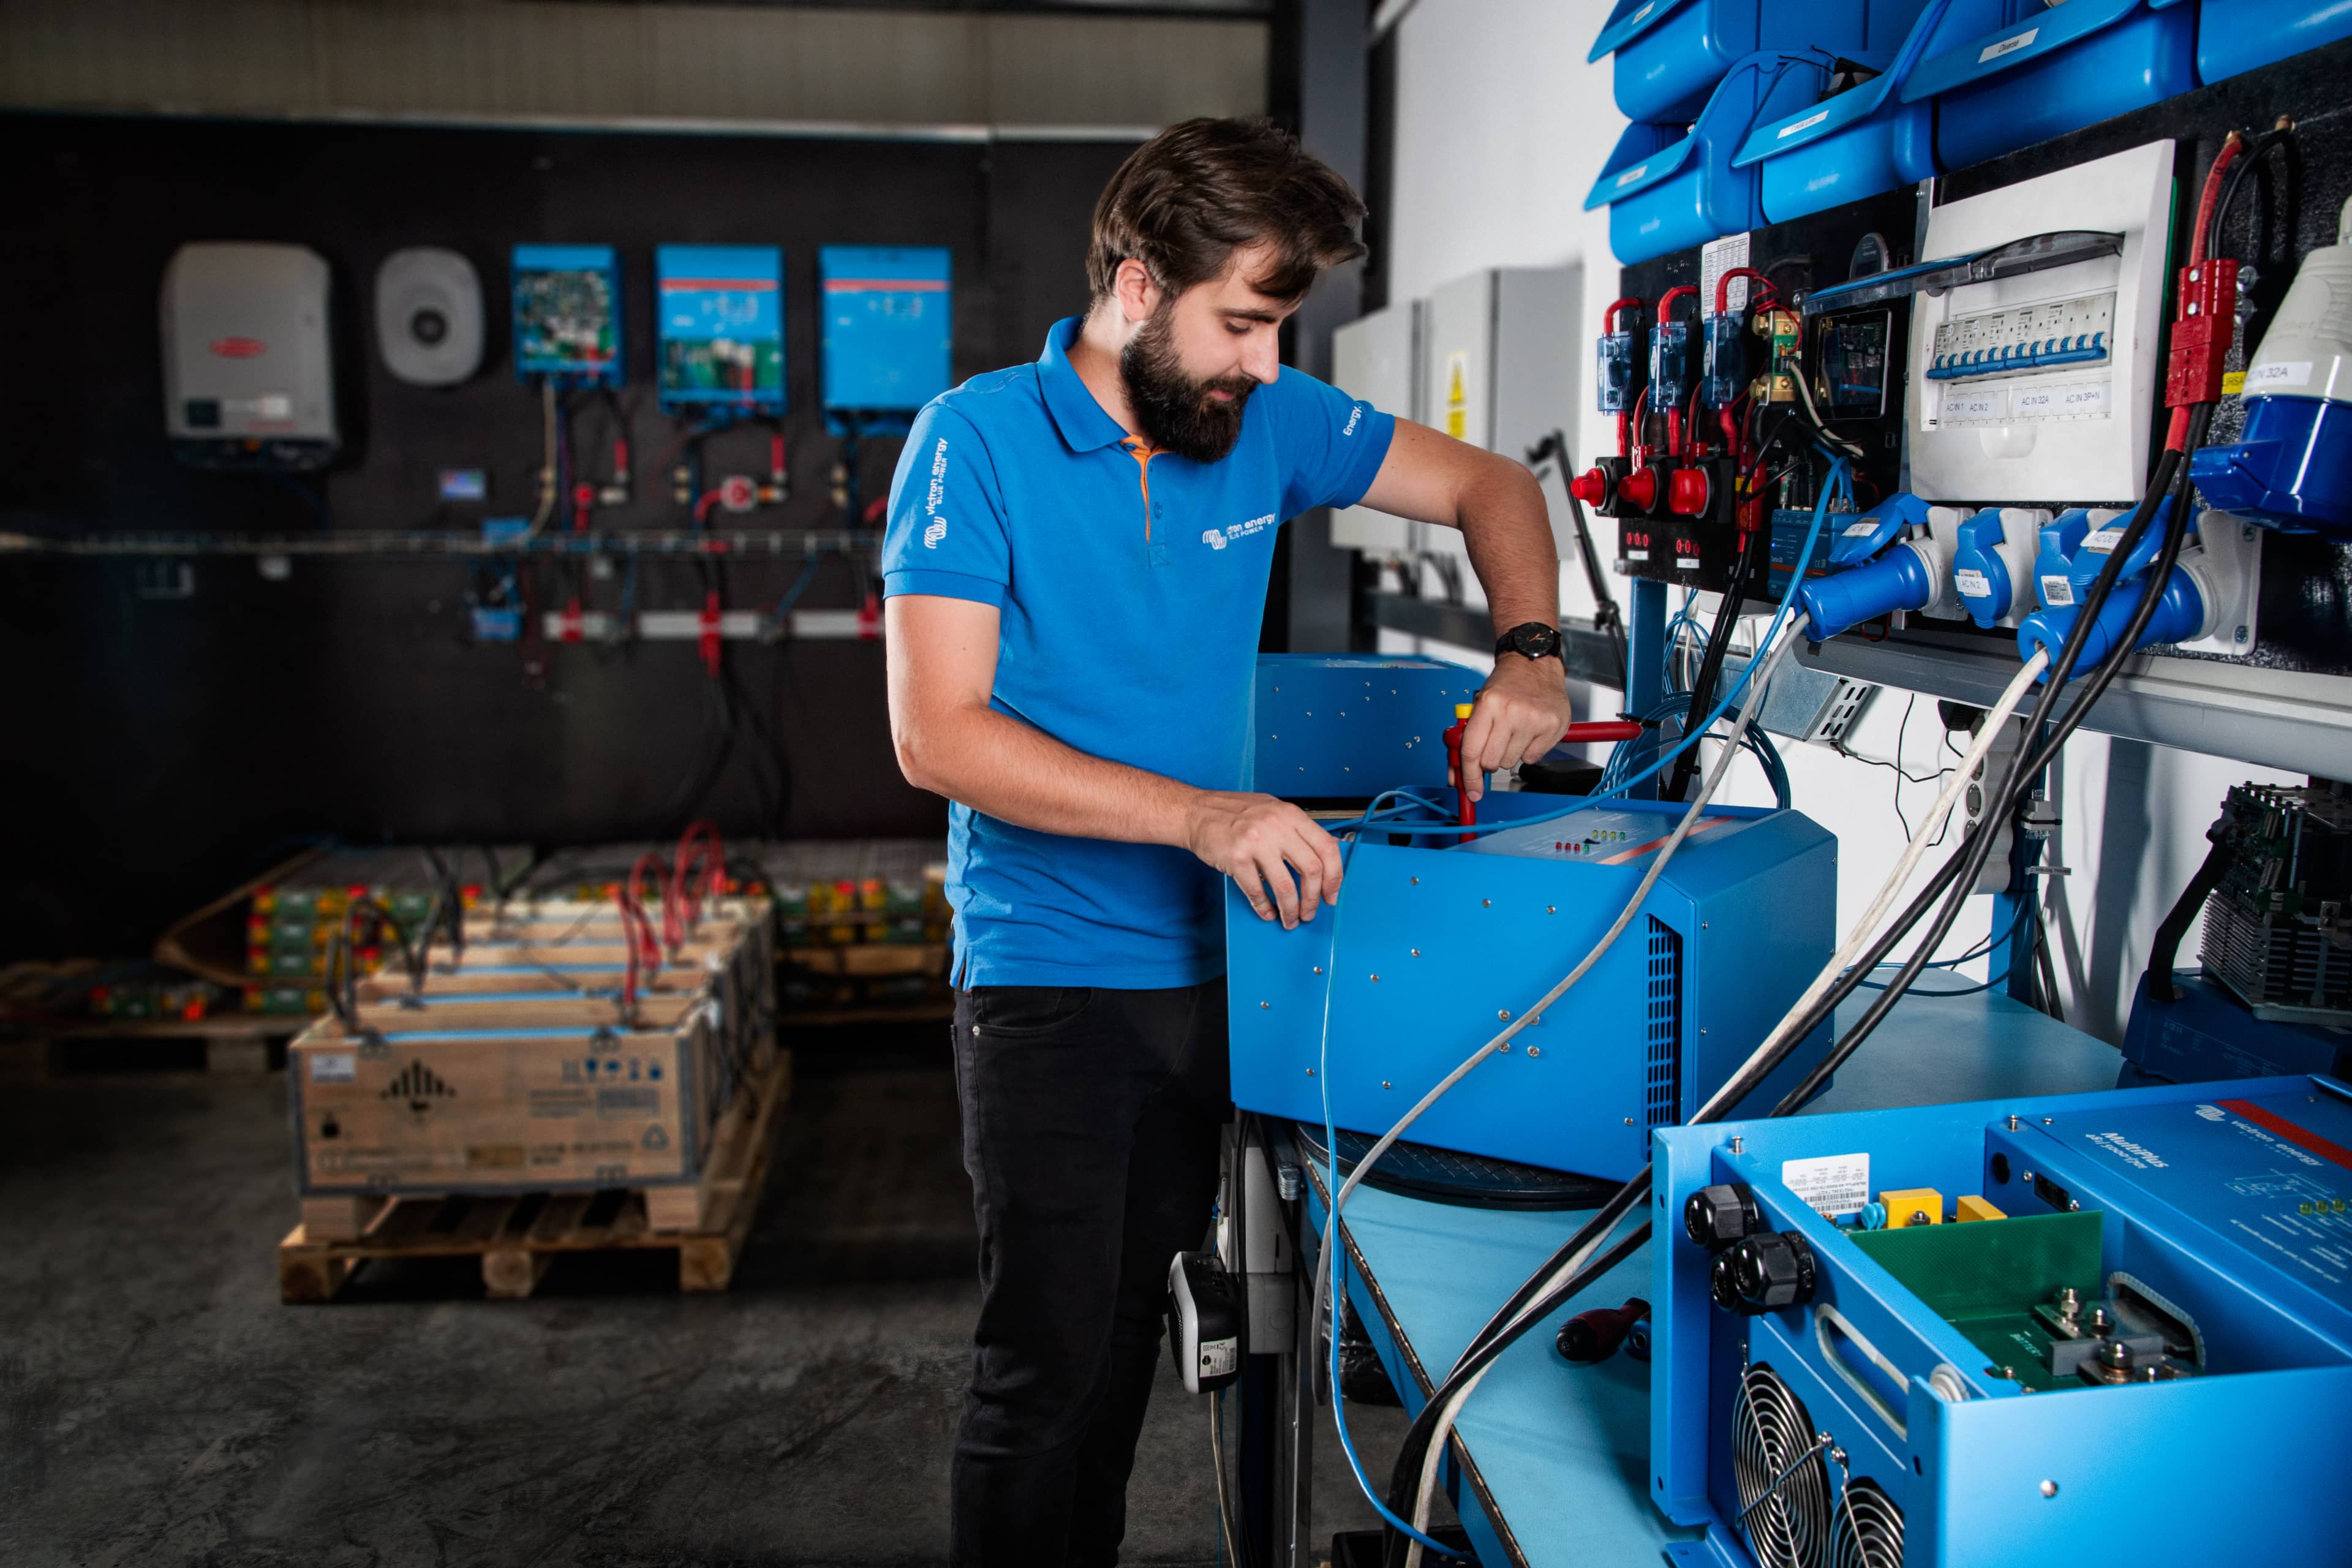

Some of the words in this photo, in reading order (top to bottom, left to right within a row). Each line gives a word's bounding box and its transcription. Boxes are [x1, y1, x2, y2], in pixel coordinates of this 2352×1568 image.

[2266, 367, 2288, 378] 32A
[2022, 397, 2029, 405] AC
[2038, 396, 2049, 404] 32A
[2066, 395, 2074, 404] AC
[1946, 403, 1954, 412] AC
[1970, 403, 1977, 412] AC
[1343, 405, 1362, 436] Energy.
[925, 478, 938, 515] victron
[932, 437, 948, 475] energy
[937, 457, 948, 483] POWER
[1244, 512, 1276, 529] energy
[1240, 525, 1264, 537] POWER
[2231, 1120, 2274, 1142] victron
[2275, 1143, 2323, 1166] energy
[2100, 1133, 2169, 1168] MultiPlus
